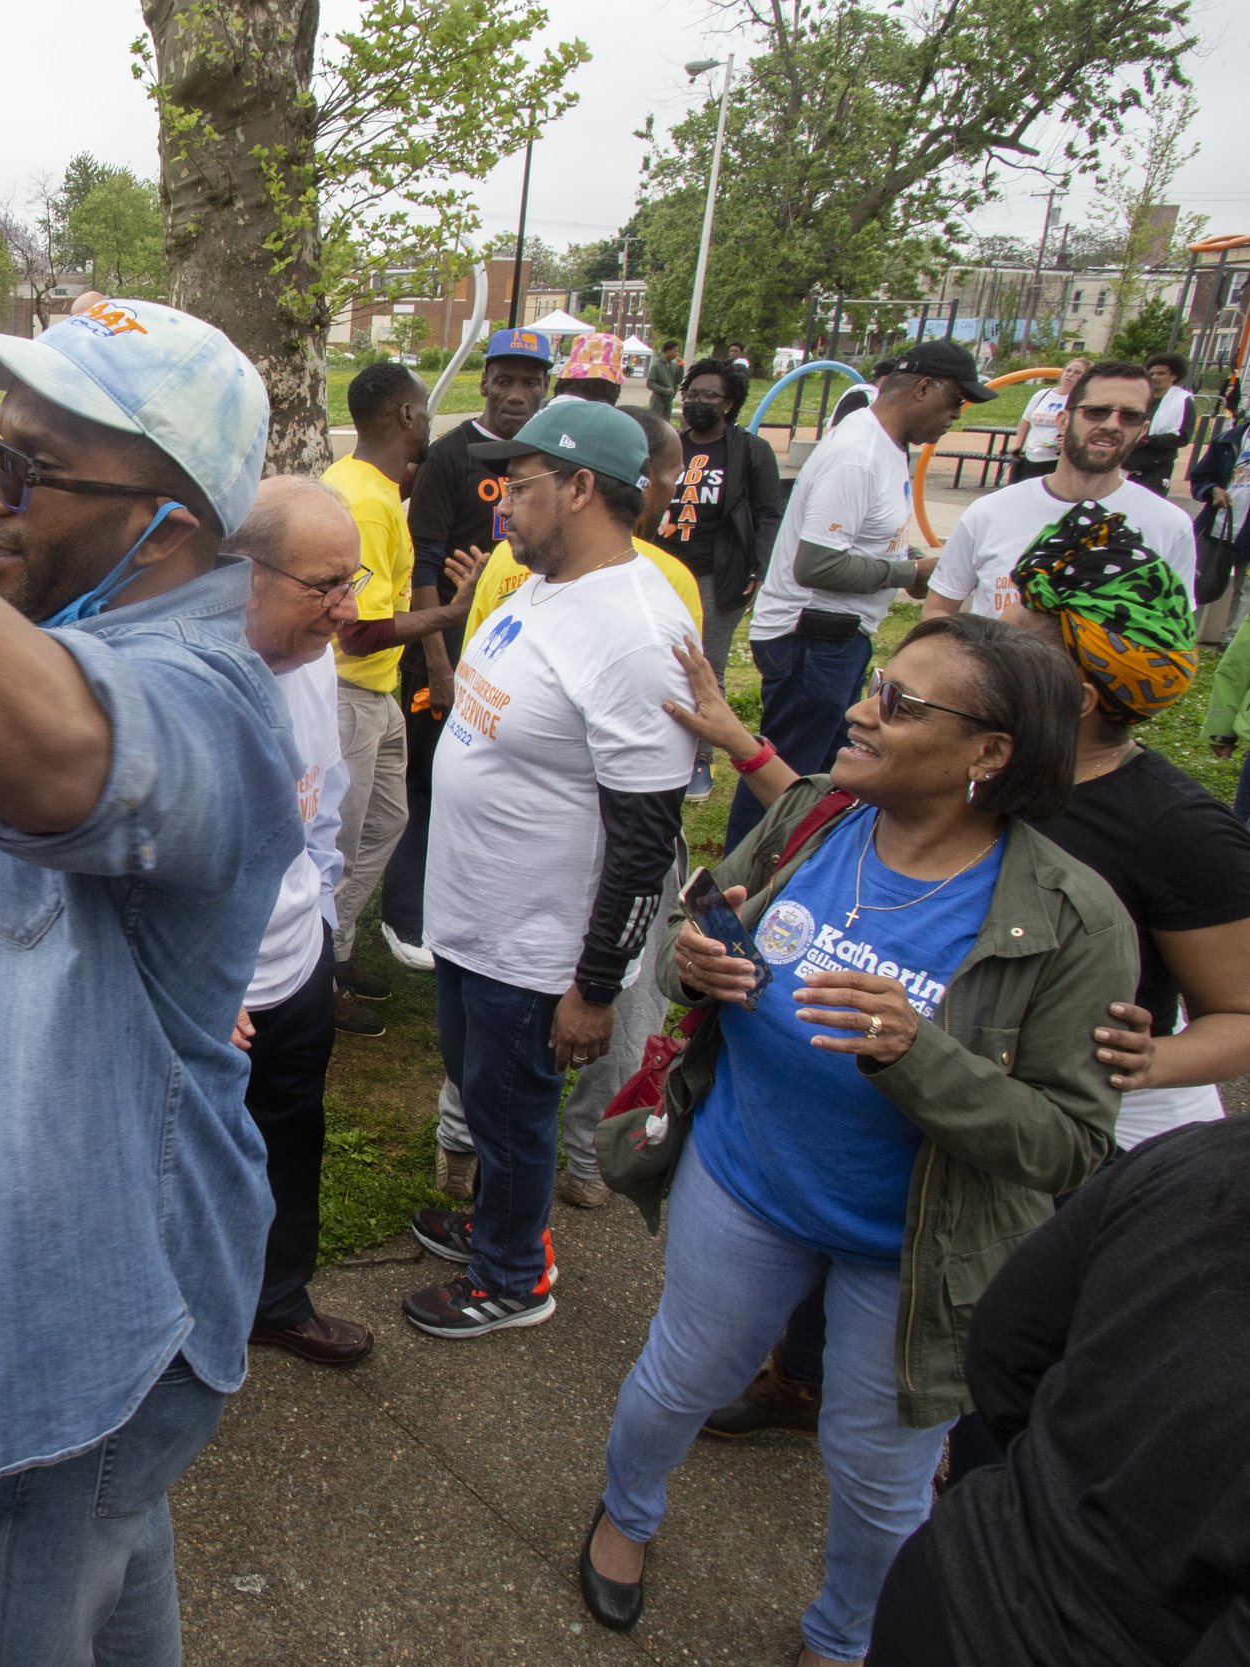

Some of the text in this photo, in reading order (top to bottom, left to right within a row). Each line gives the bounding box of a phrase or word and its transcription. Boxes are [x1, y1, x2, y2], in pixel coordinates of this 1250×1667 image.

[677, 454, 710, 542] ODAAT
[498, 571, 531, 595] STREE
[460, 692, 501, 741] SERVICE
[813, 923, 946, 1005] Katherin
